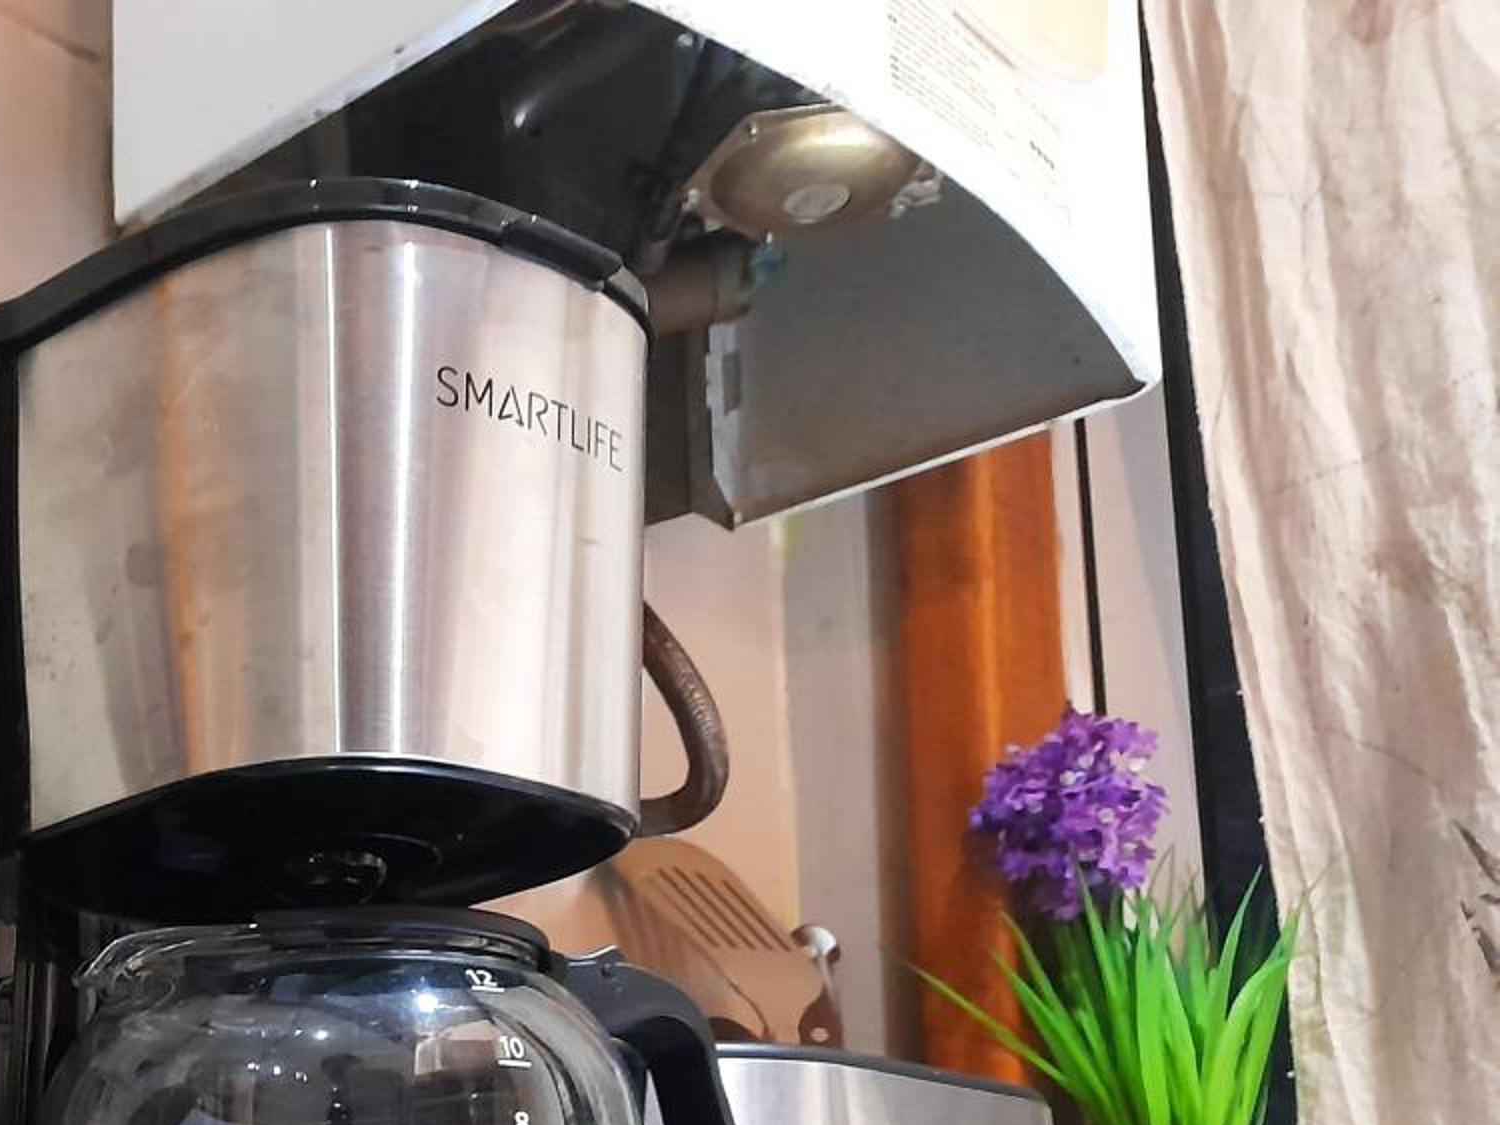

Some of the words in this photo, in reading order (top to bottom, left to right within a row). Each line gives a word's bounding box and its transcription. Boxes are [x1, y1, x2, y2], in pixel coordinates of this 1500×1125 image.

[436, 365, 623, 472] SMARTLIFE
[465, 969, 498, 987] 12
[499, 1036, 525, 1059] 10
